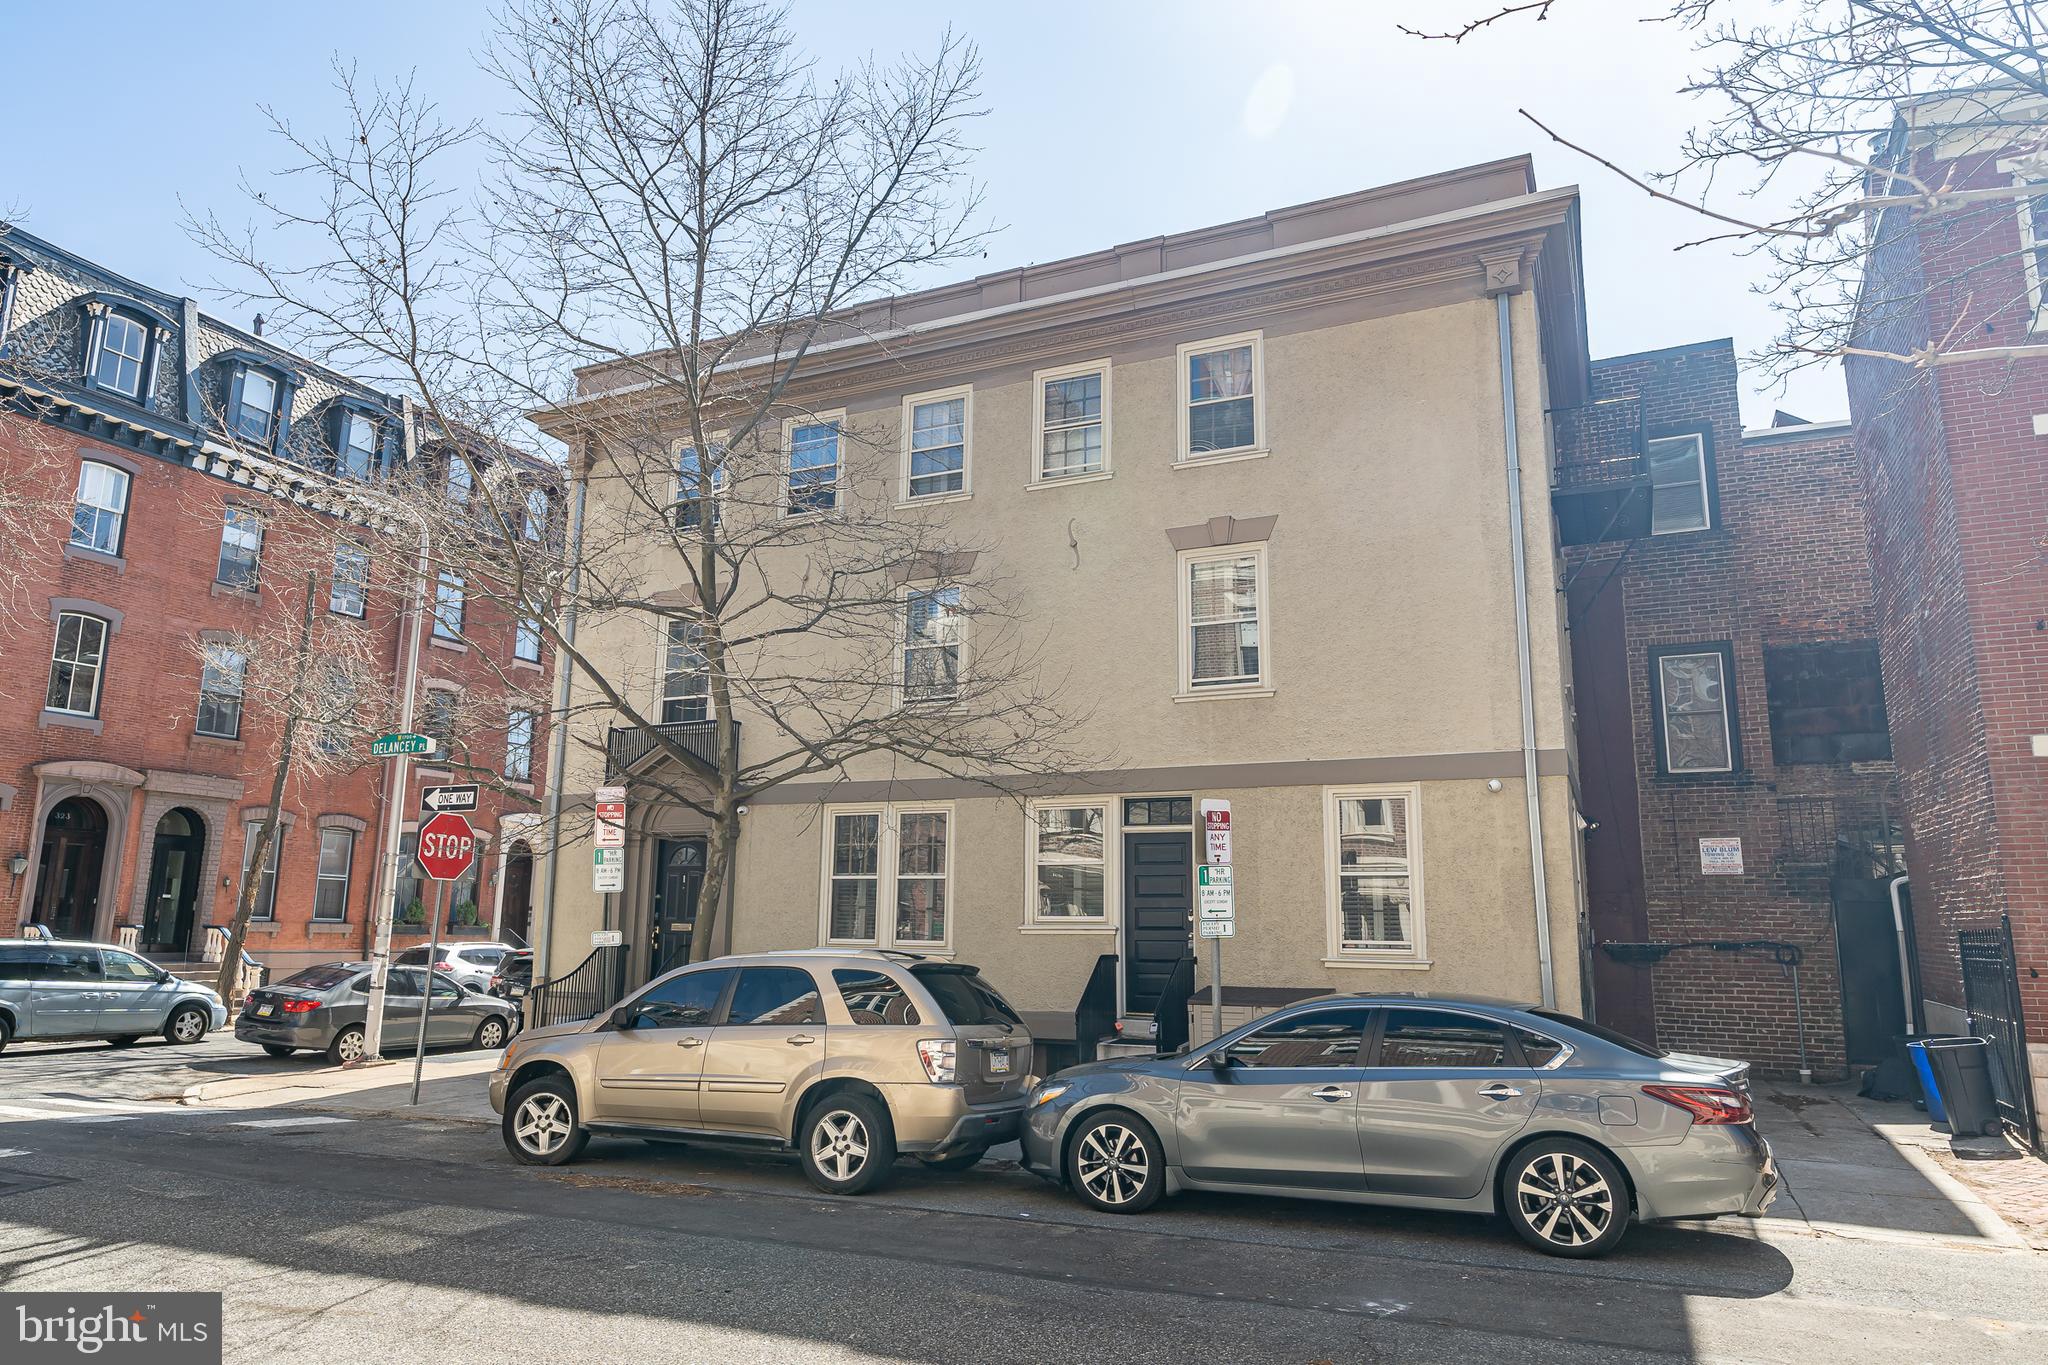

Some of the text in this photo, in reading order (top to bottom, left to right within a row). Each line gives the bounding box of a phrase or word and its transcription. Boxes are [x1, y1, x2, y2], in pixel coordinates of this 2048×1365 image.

[373, 740, 426, 754] DELANCEY PL
[438, 792, 472, 804] ONE WAY
[1211, 811, 1222, 822] NO
[1207, 822, 1230, 830] STOPPING
[603, 828, 617, 836] TIME
[1210, 833, 1226, 841] ANY
[423, 832, 472, 859] STOP
[1210, 843, 1227, 851] TIME
[597, 851, 601, 864] 1
[1203, 869, 1208, 883] 1
